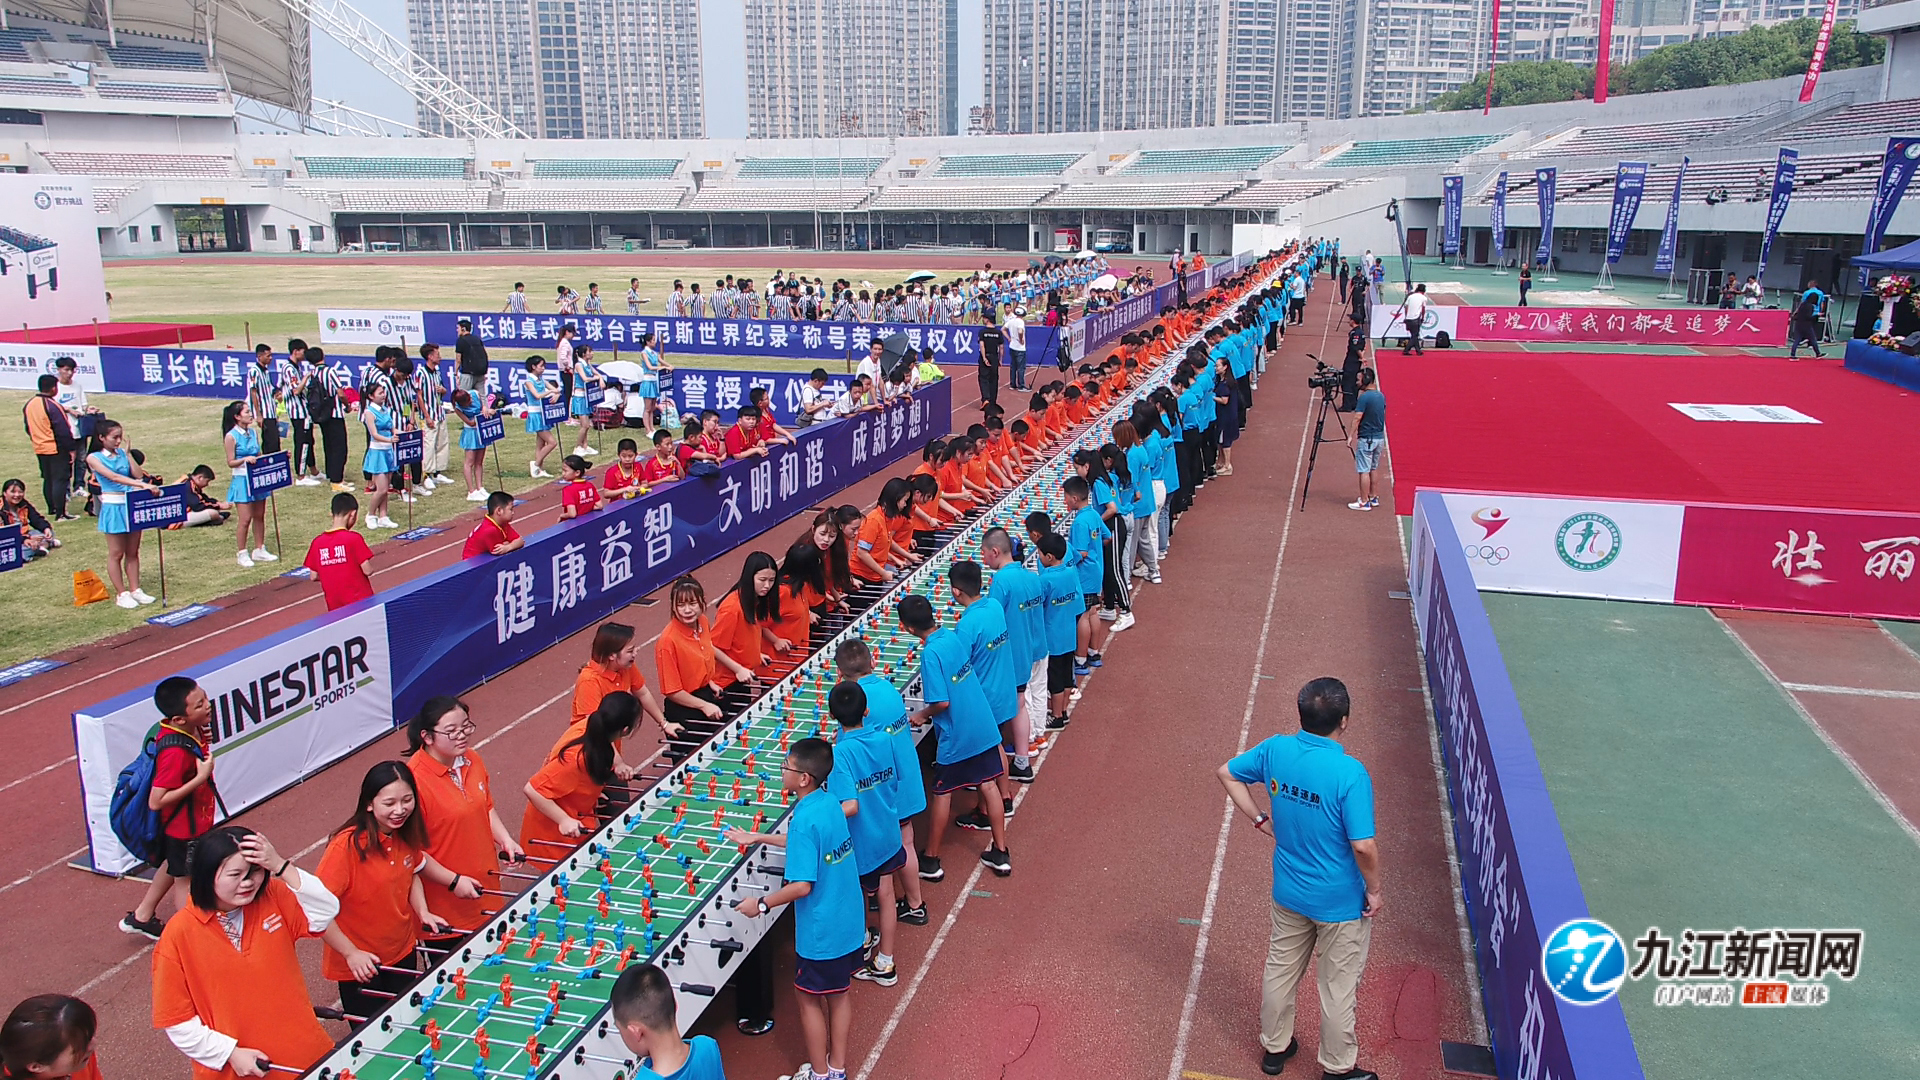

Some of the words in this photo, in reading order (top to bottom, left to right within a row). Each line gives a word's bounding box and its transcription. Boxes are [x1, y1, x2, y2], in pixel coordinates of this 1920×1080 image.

[1479, 311, 1761, 335] 辉煌70载我们都是追梦人
[319, 545, 346, 560] 深圳
[313, 681, 356, 712] SPORTS
